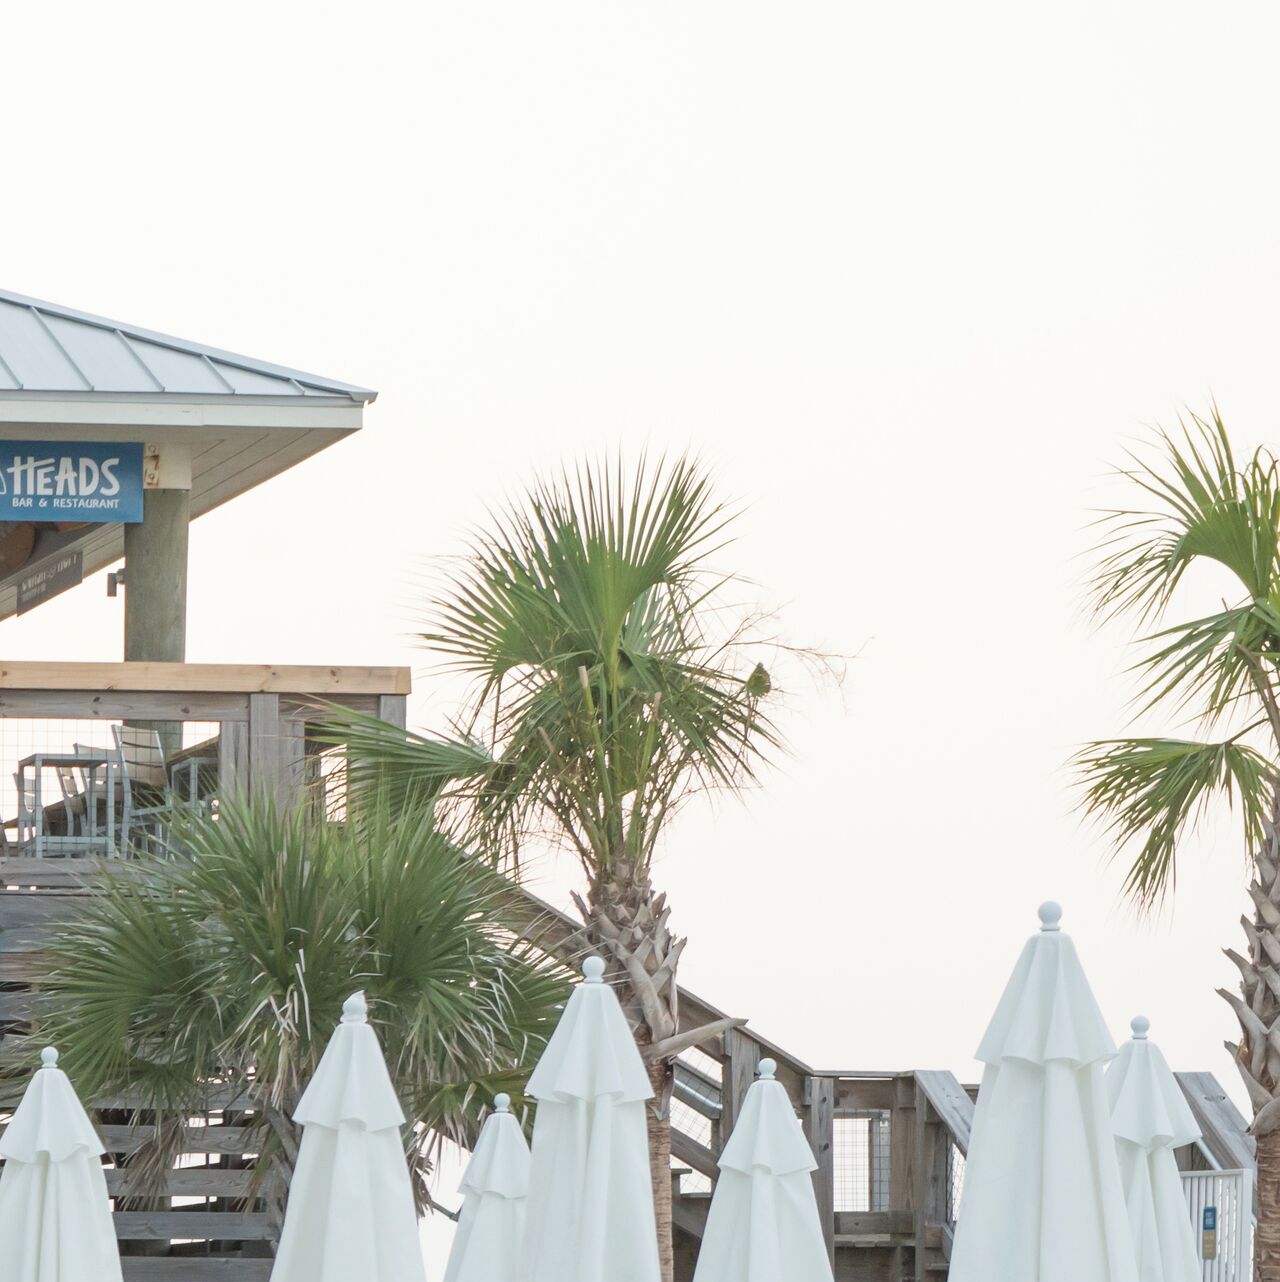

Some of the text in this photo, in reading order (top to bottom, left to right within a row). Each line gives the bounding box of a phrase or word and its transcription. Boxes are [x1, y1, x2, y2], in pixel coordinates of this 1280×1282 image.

[7, 456, 120, 496] HEADS
[12, 498, 119, 509] BAR & RESTAURANT
